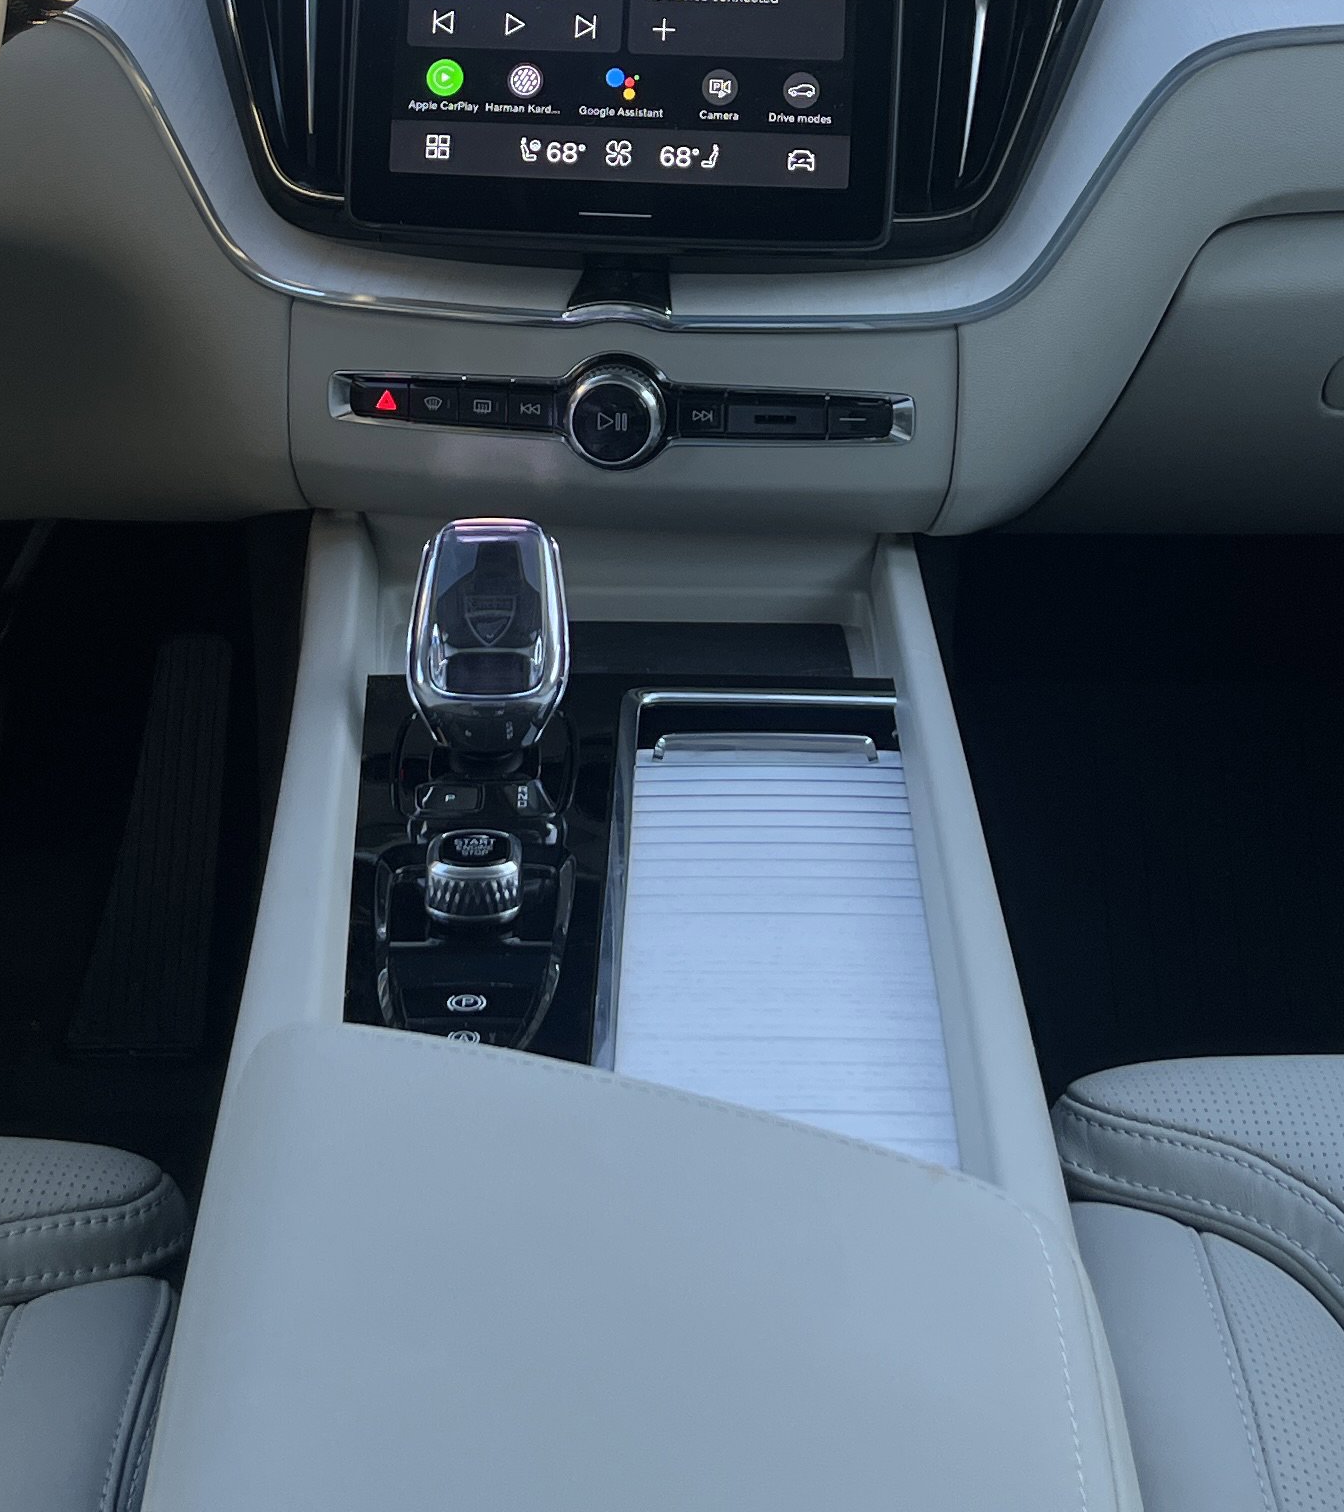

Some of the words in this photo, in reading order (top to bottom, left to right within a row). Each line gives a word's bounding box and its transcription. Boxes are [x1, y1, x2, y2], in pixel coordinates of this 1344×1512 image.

[408, 100, 438, 112] Apple
[440, 101, 479, 113] CarPlay
[485, 103, 525, 113] Harman
[579, 106, 615, 118] Google
[617, 107, 663, 118] Assistant
[699, 110, 739, 121] Camera
[768, 112, 795, 123] Drive
[797, 113, 832, 124] modes
[546, 141, 586, 163] 68°
[659, 146, 699, 168] 68°
